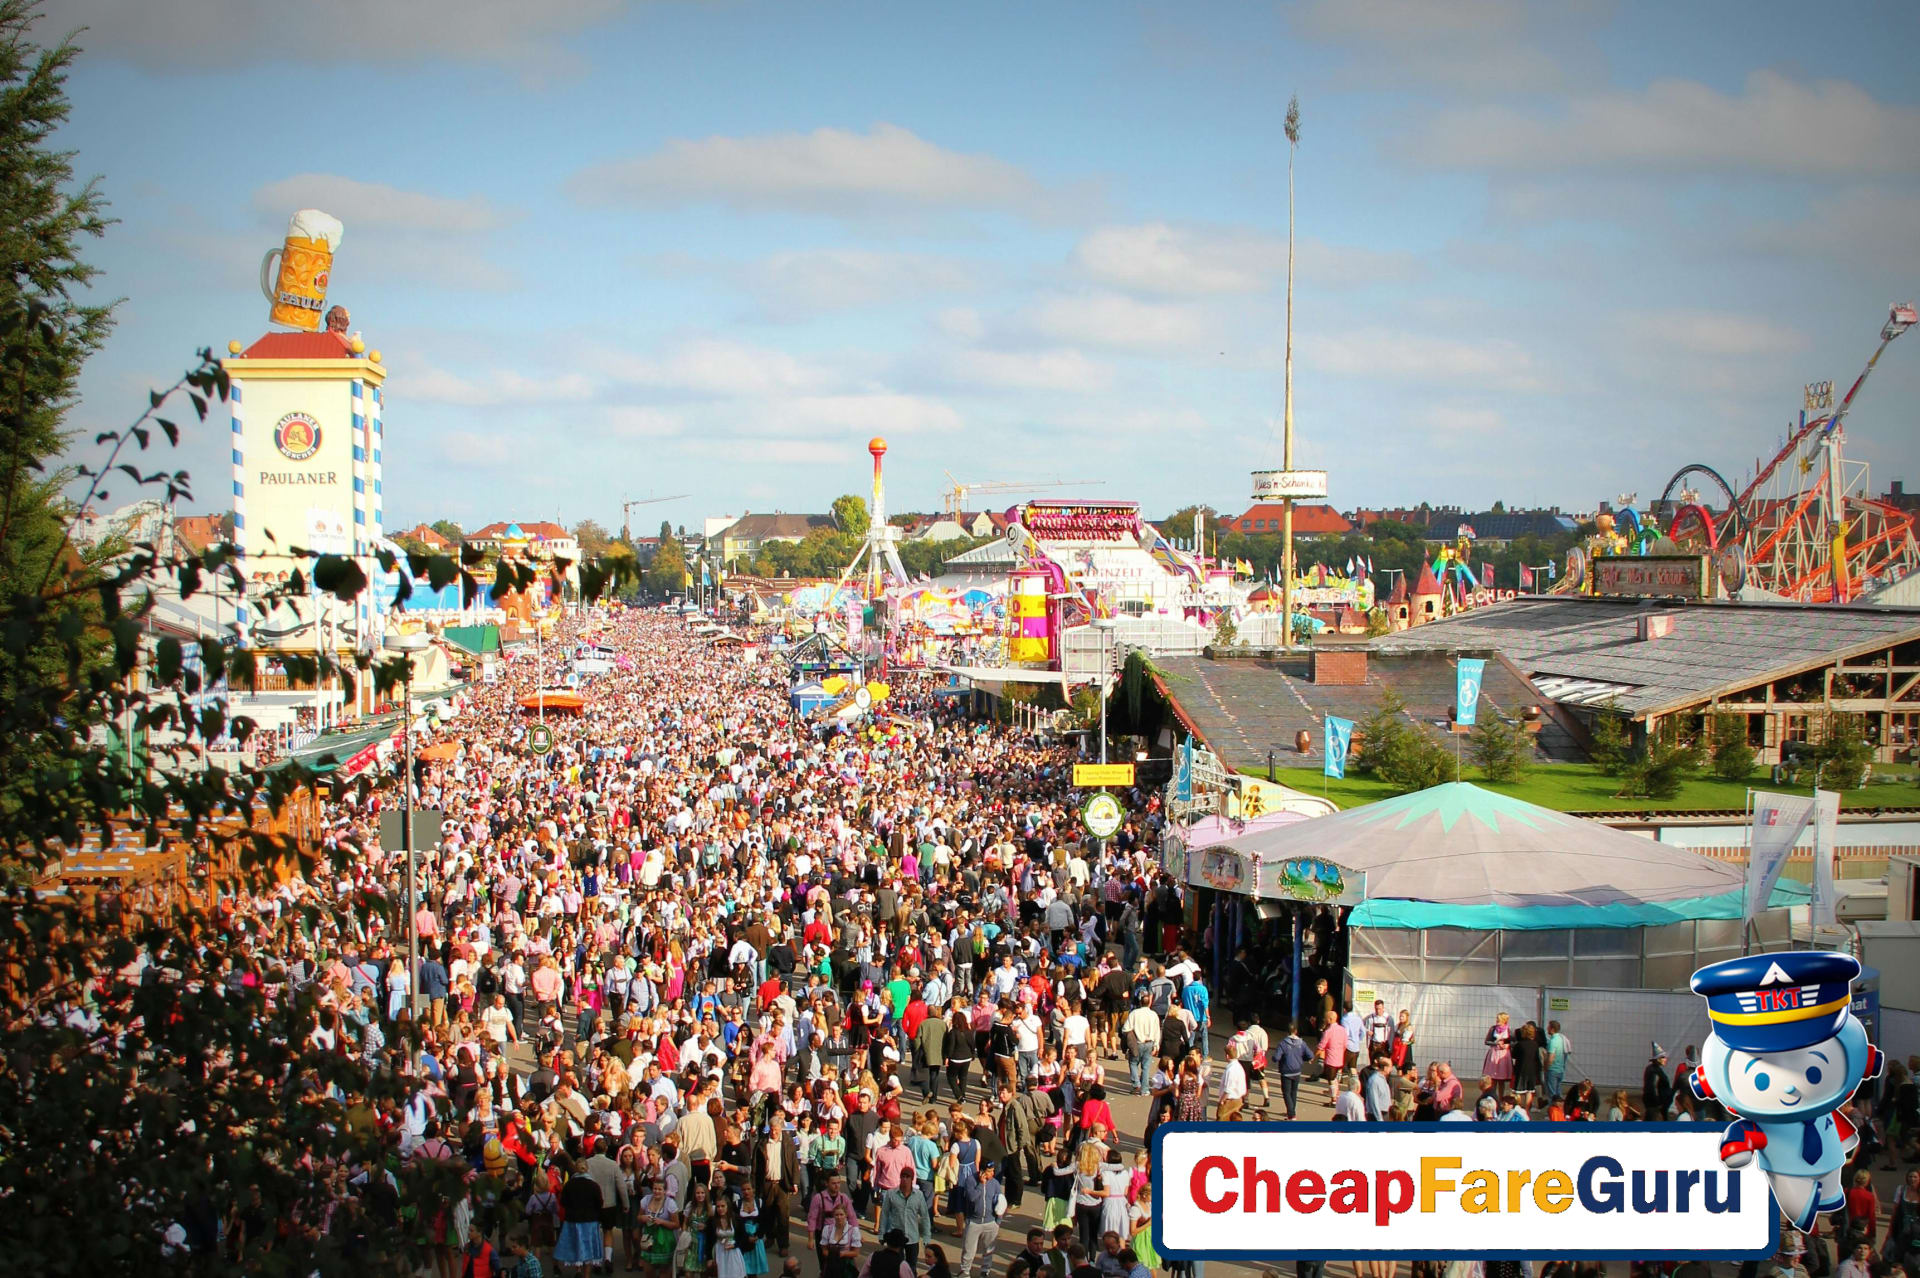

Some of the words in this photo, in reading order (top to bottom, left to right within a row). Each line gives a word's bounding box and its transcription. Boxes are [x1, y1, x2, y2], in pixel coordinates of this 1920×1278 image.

[276, 412, 320, 431] PAULANER
[259, 471, 337, 485] PAULANER
[1466, 588, 1527, 605] SCHLO
